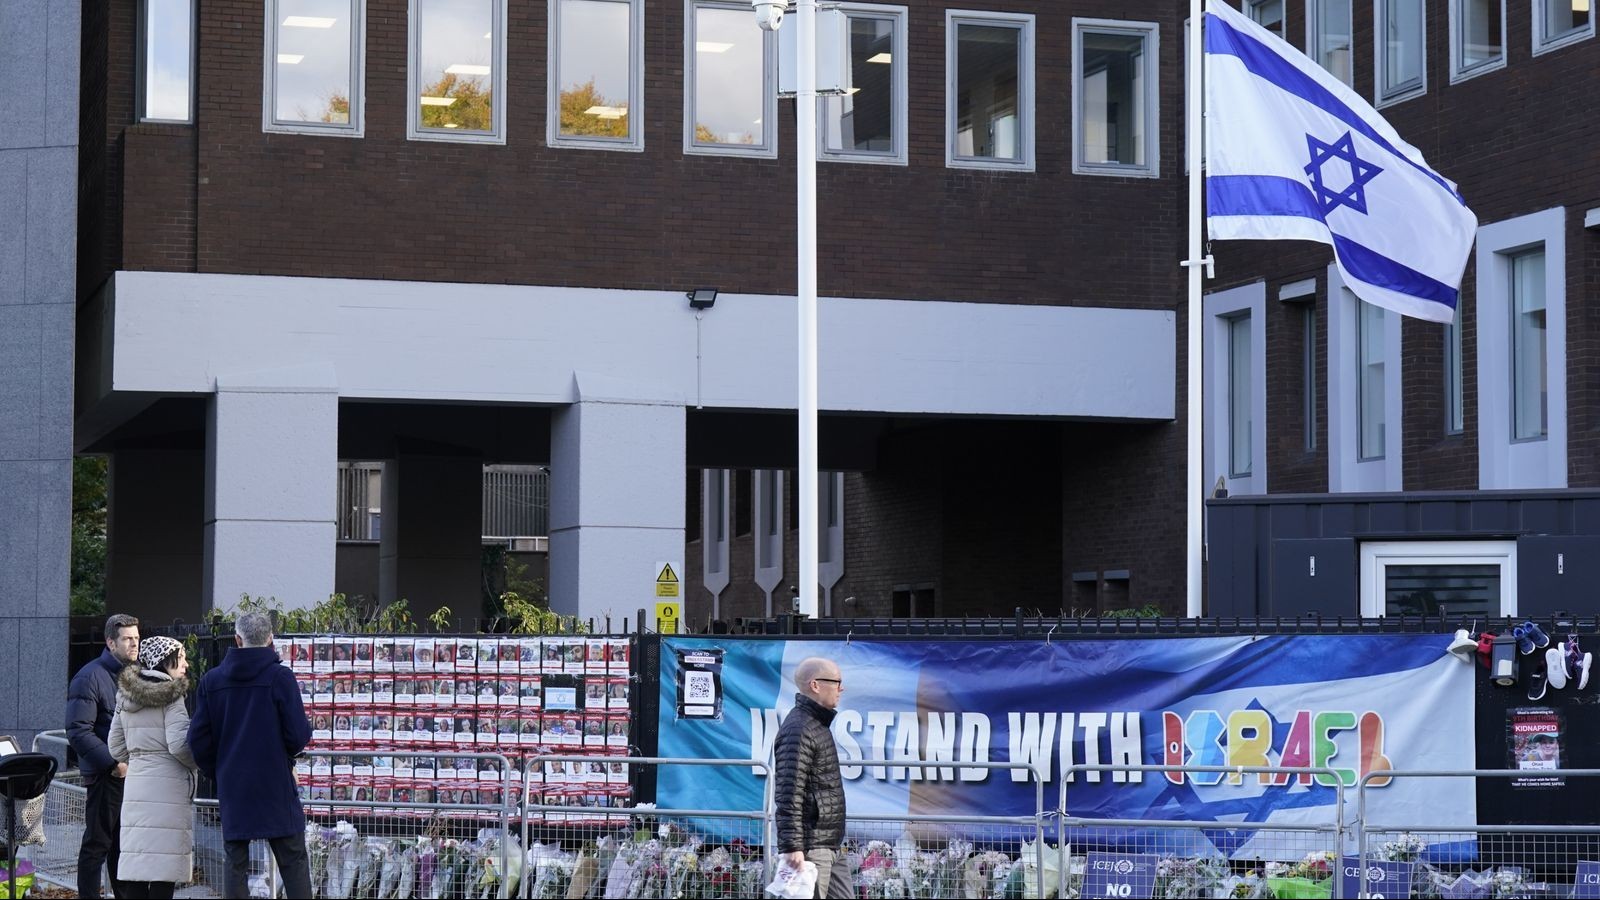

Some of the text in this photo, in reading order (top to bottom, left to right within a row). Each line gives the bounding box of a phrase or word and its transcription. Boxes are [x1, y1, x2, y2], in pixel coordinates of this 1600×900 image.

[834, 709, 990, 781] STAND
[1009, 711, 1143, 784] WITH
[1162, 709, 1394, 787] ISRAEL
[1092, 860, 1115, 873] ICEJ
[1105, 883, 1132, 898] NO
